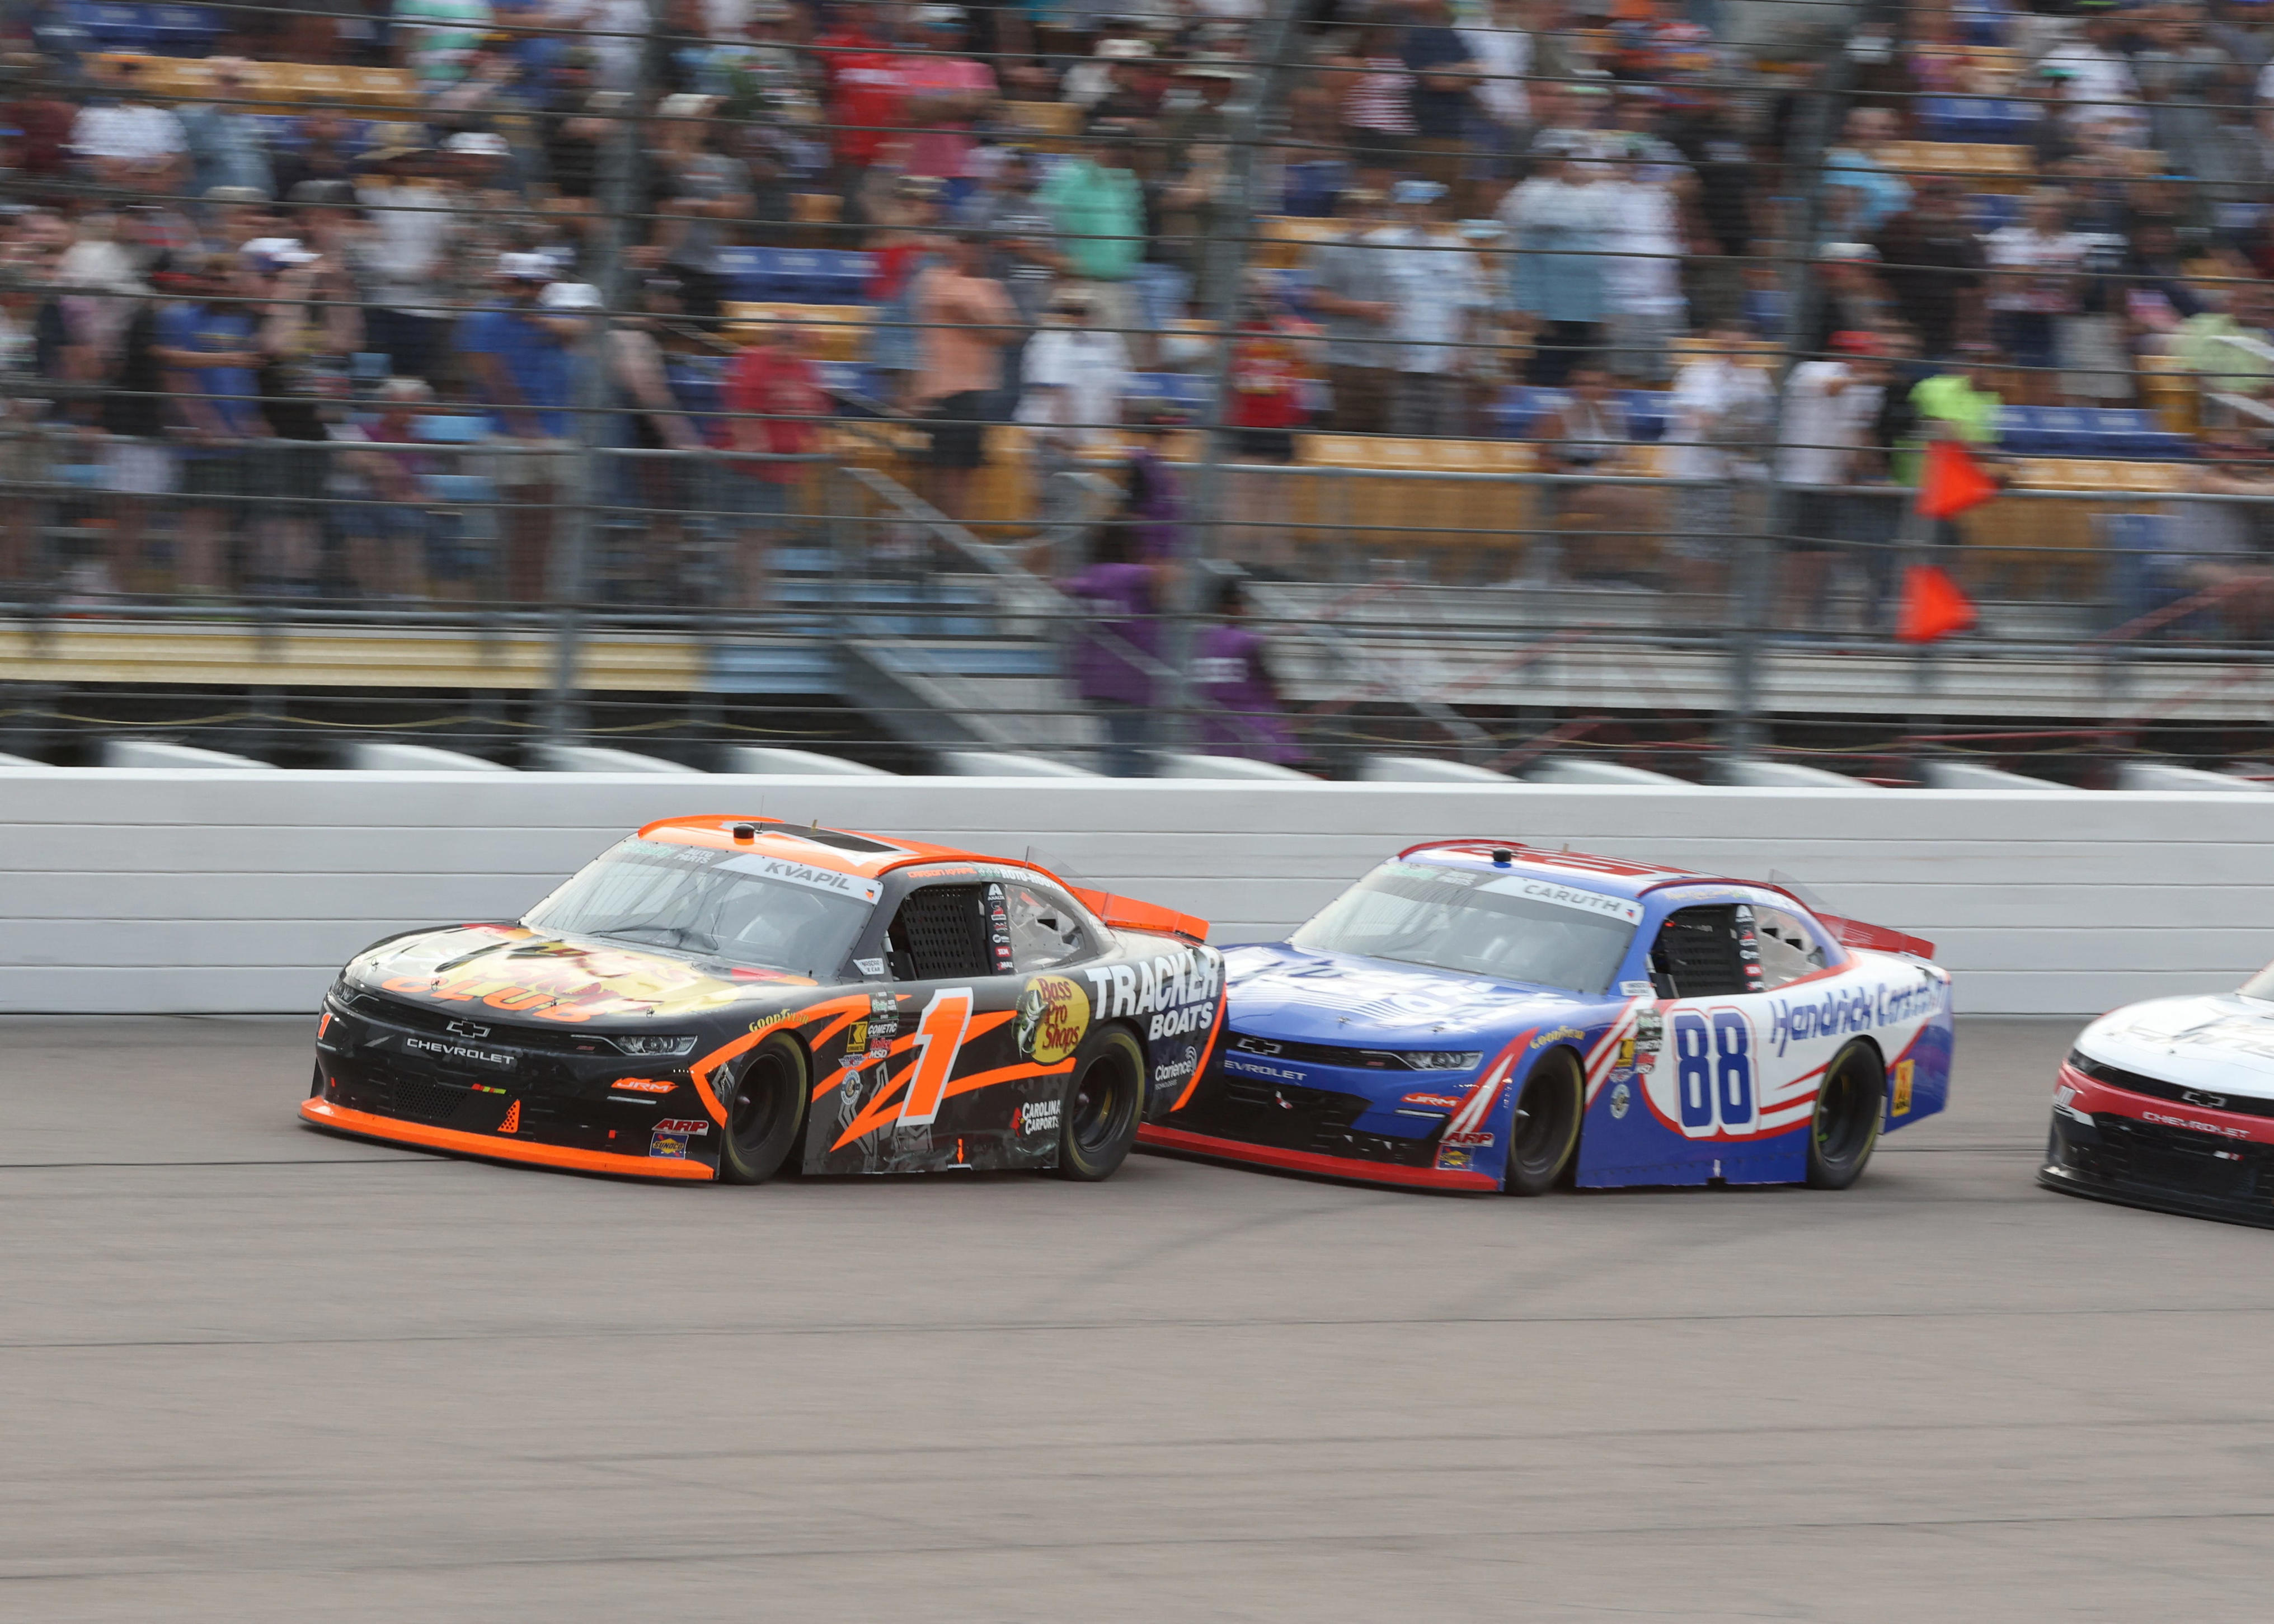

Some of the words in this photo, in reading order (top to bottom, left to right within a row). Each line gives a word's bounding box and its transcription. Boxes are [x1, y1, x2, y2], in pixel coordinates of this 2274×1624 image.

[673, 854, 711, 864] PARTS
[684, 849, 715, 858] AUTO
[765, 862, 850, 891] KVAPIL
[1524, 882, 1622, 912] CARUTH
[1036, 978, 1072, 1001] Bass
[1084, 945, 1220, 1020] TRACKER
[381, 976, 605, 1023] CLUB
[1044, 1000, 1068, 1025] Pro
[1149, 1001, 1214, 1041] BOATS
[1768, 986, 1873, 1058] Hendrick
[868, 1023, 898, 1035] COMETIC
[1042, 1024, 1080, 1053] Shops
[407, 1038, 514, 1065] CHEVROLET
[868, 1049, 888, 1059] MSD
[896, 987, 974, 1127] 1
[1155, 1060, 1192, 1082] Clarience
[1224, 1060, 1308, 1081] EVROLET
[1671, 1010, 1755, 1131] 88
[617, 1081, 669, 1091] JRM
[1022, 1099, 1061, 1121] CAROLINA
[655, 1119, 708, 1132] ARP
[1025, 1116, 1059, 1136] CARPORTS
[2143, 1111, 2250, 1138] CHEVROLET
[653, 1141, 684, 1151] SUNOCO
[1445, 1132, 1493, 1143] ARP
